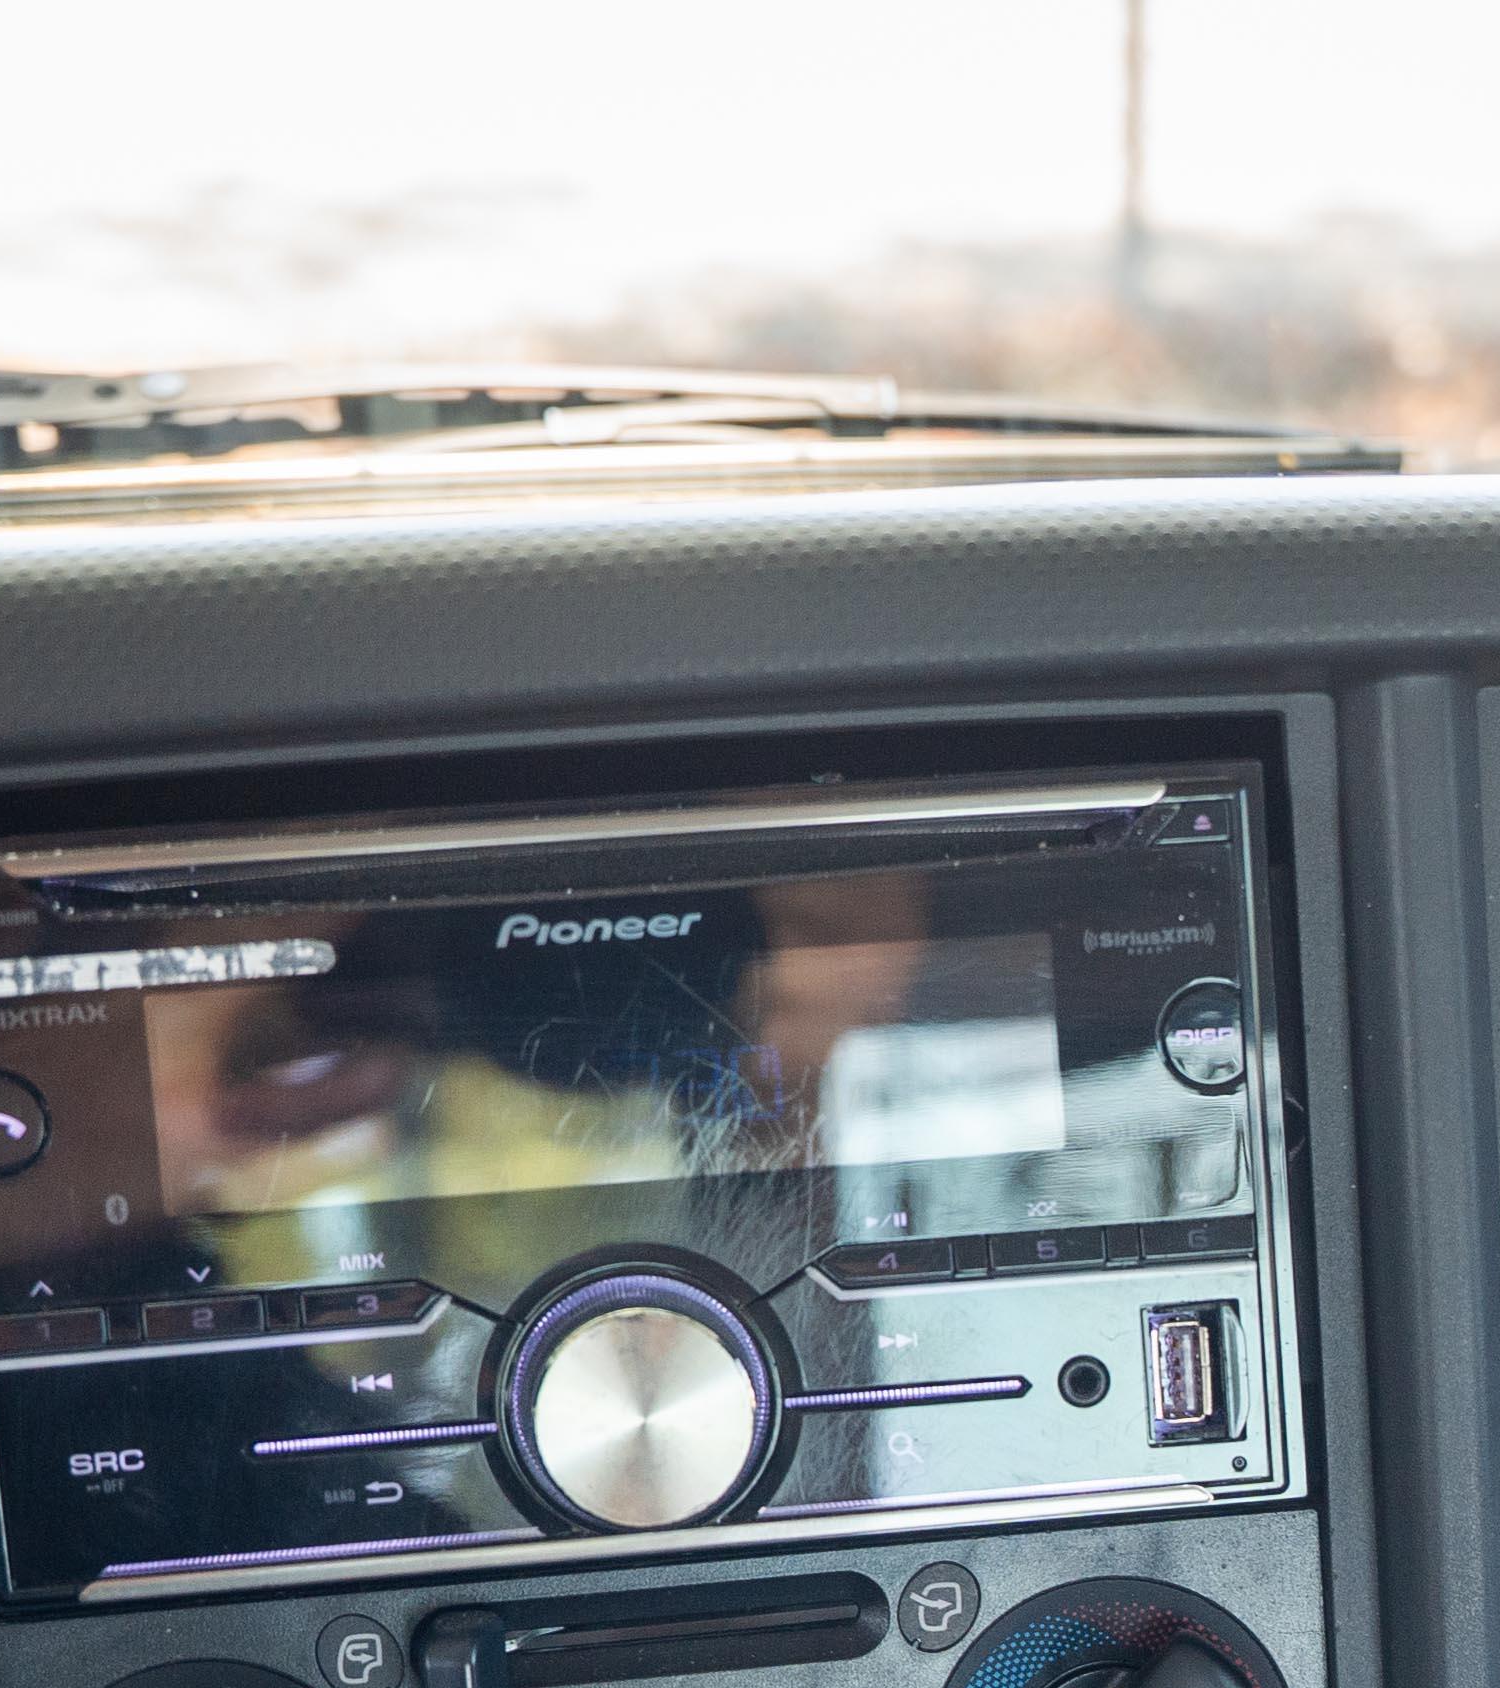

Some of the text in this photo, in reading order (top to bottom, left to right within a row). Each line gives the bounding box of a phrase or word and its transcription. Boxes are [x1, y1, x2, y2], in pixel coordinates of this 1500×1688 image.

[497, 911, 702, 949] Pioneer
[1036, 1239, 1059, 1260] 5
[339, 1252, 385, 1274] MIX
[877, 1252, 900, 1272] 4
[357, 1295, 380, 1316] 3
[192, 1306, 214, 1328] 2
[69, 1449, 146, 1476] SRC
